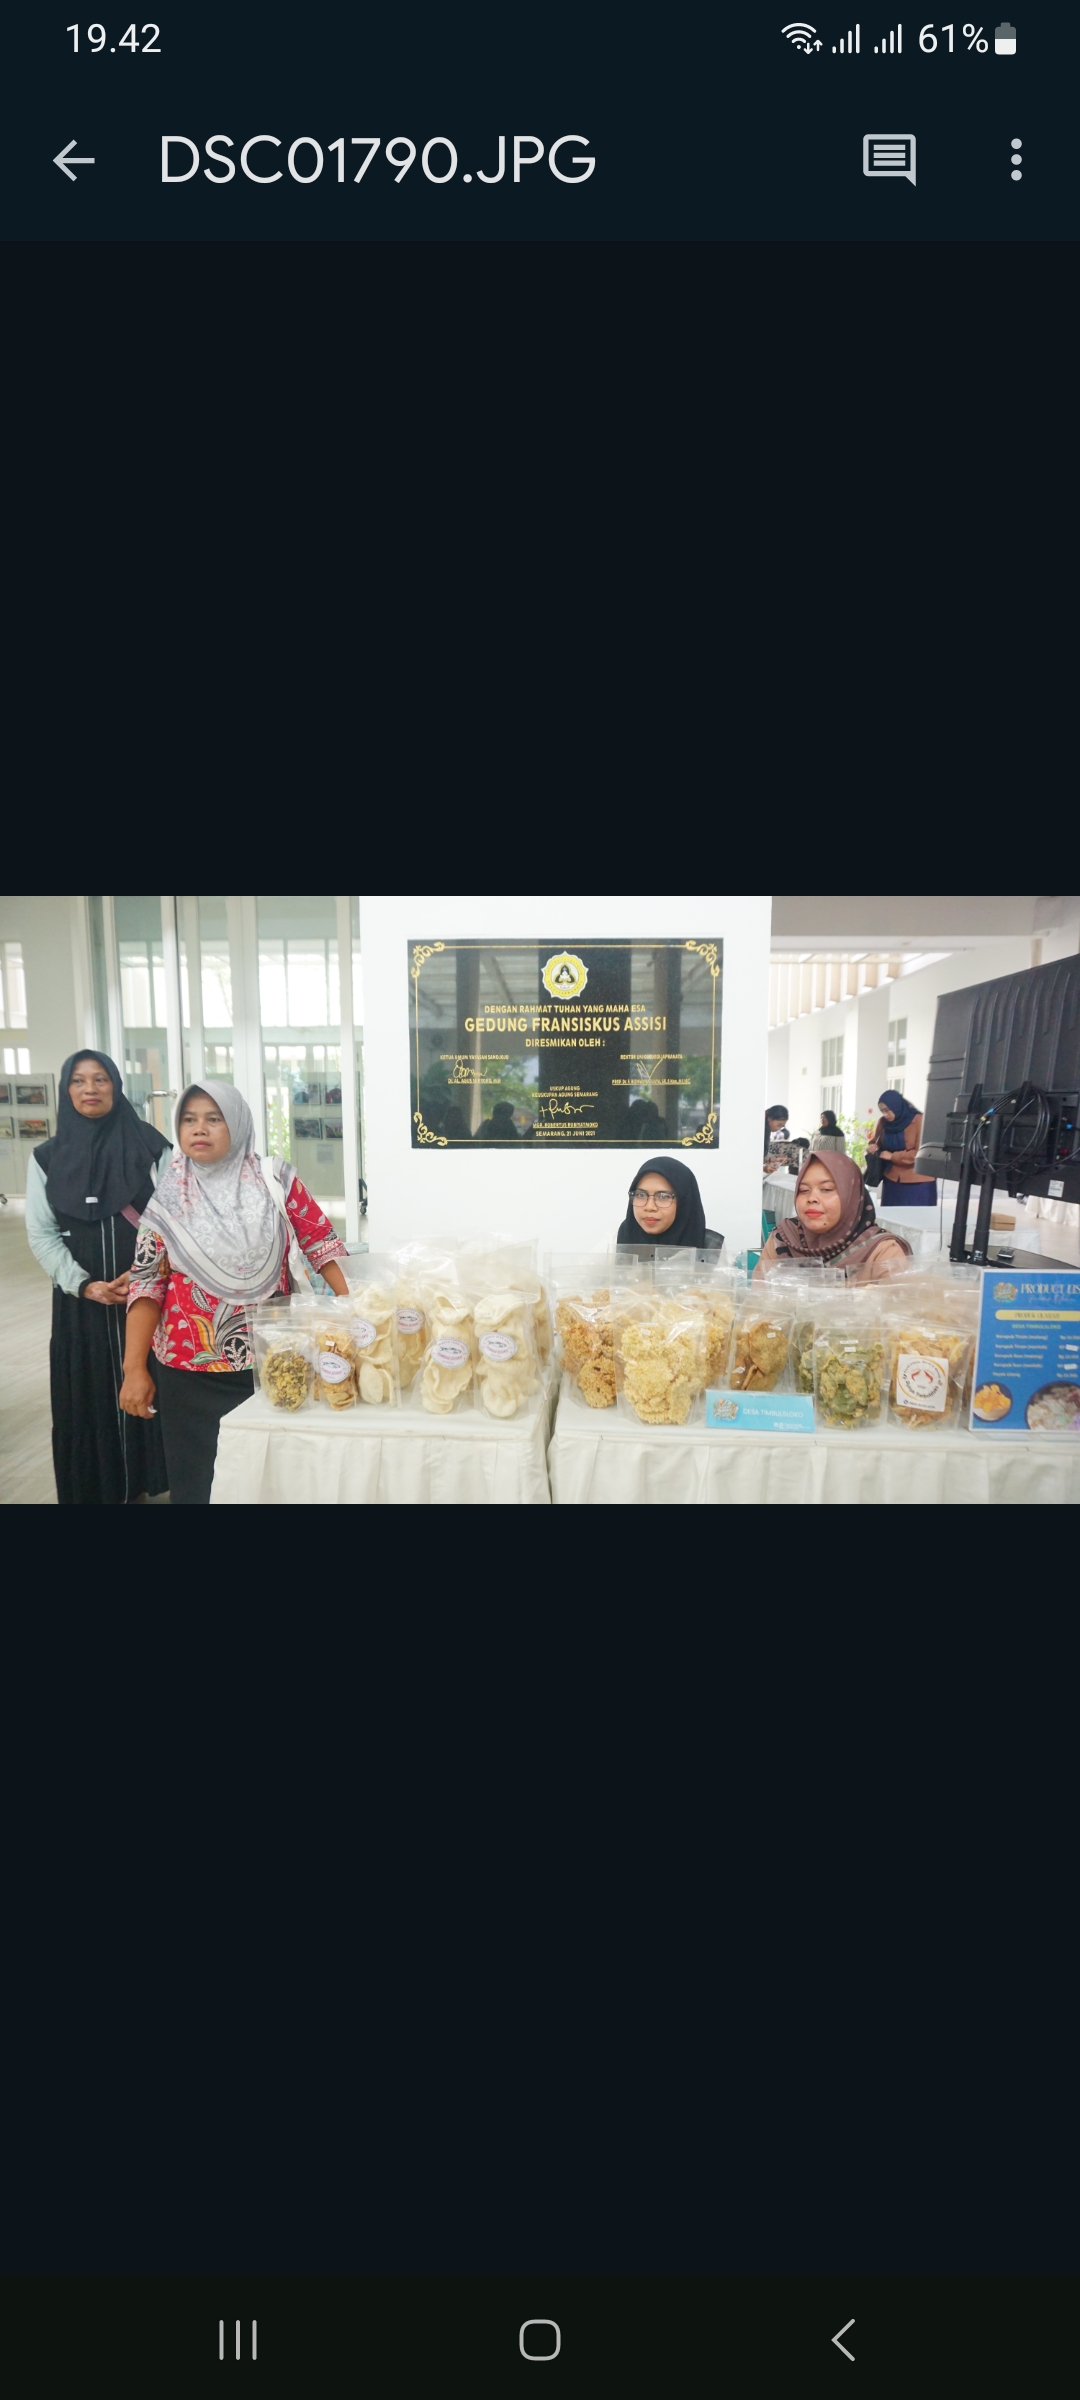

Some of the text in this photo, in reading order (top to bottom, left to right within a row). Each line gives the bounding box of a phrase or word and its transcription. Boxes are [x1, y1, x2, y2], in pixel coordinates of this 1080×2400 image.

[484, 1004, 646, 1014] DENGAN RAHMAT TUHAN YANG MAHA ESA
[464, 1016, 667, 1032] GEDUNG FRANSISKUS ASSISI
[525, 1038, 577, 1048] DIRESMIKAN
[578, 1038, 601, 1047] OLEH
[1020, 1283, 1065, 1294] PRODUCT
[761, 1410, 804, 1418] TIMBULSLOKO
